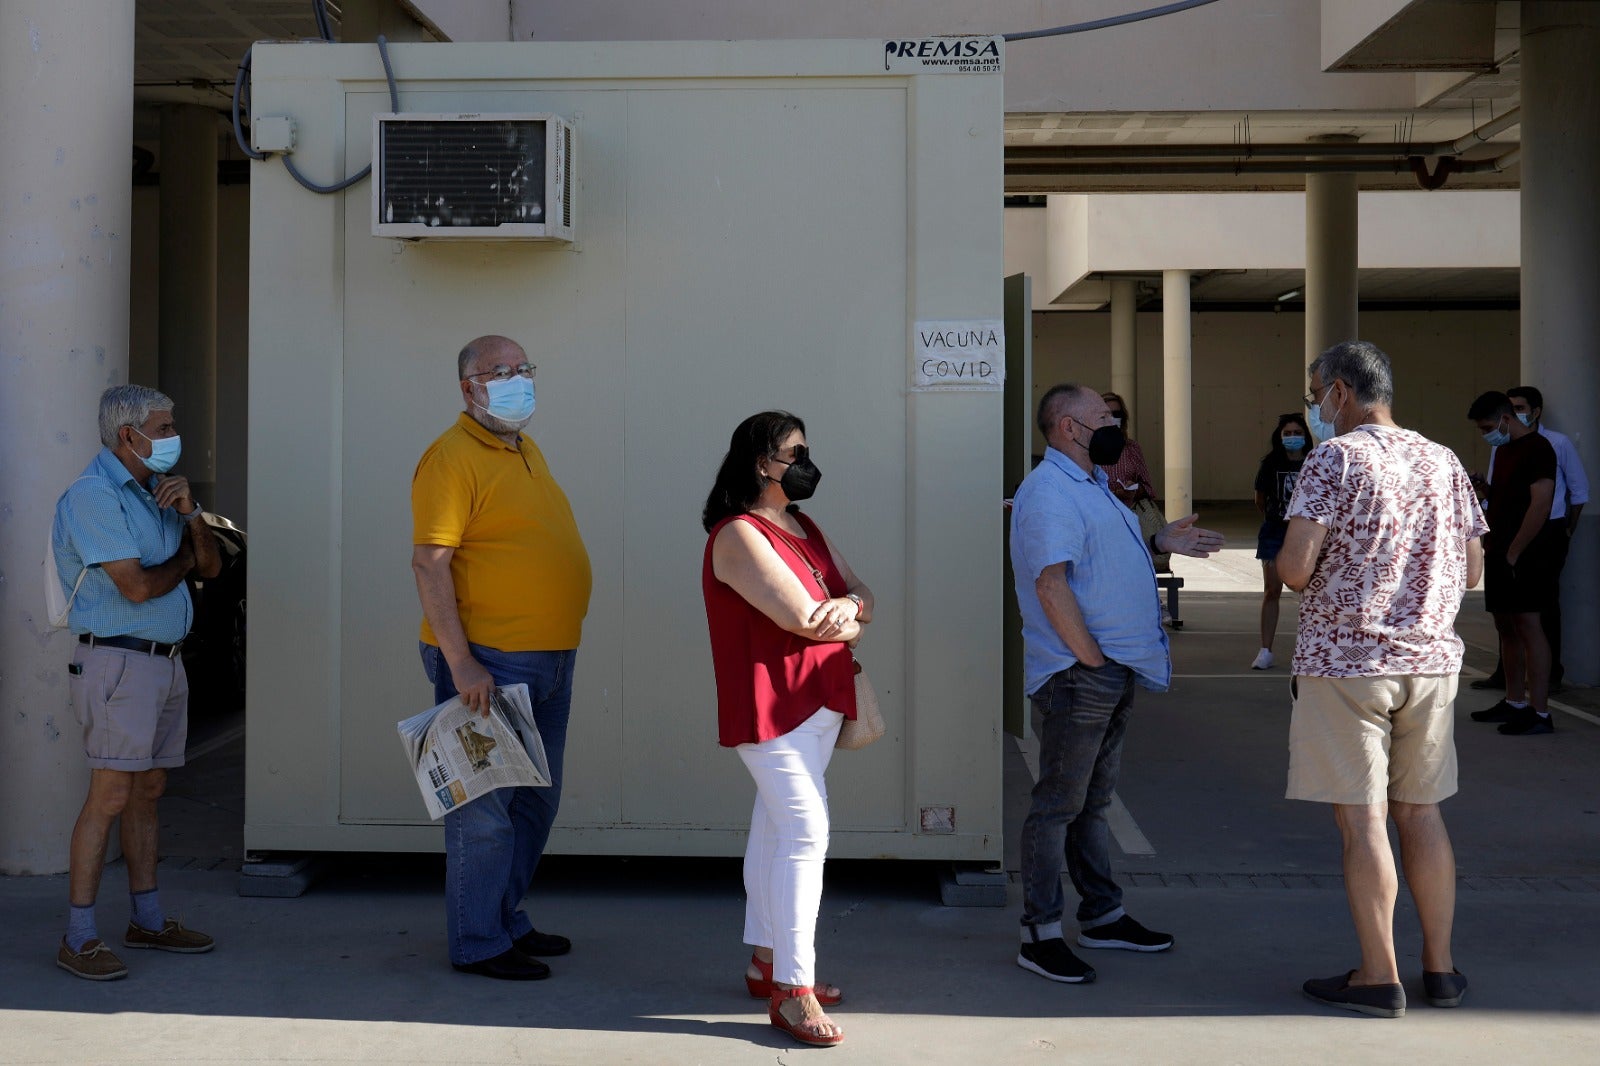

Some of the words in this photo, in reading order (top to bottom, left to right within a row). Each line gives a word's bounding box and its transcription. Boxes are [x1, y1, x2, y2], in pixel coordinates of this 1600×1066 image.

[897, 40, 1000, 57] REMSA
[922, 57, 1000, 65] www.remsa.net
[920, 330, 998, 348] VACUNA
[922, 359, 992, 378] COVID
